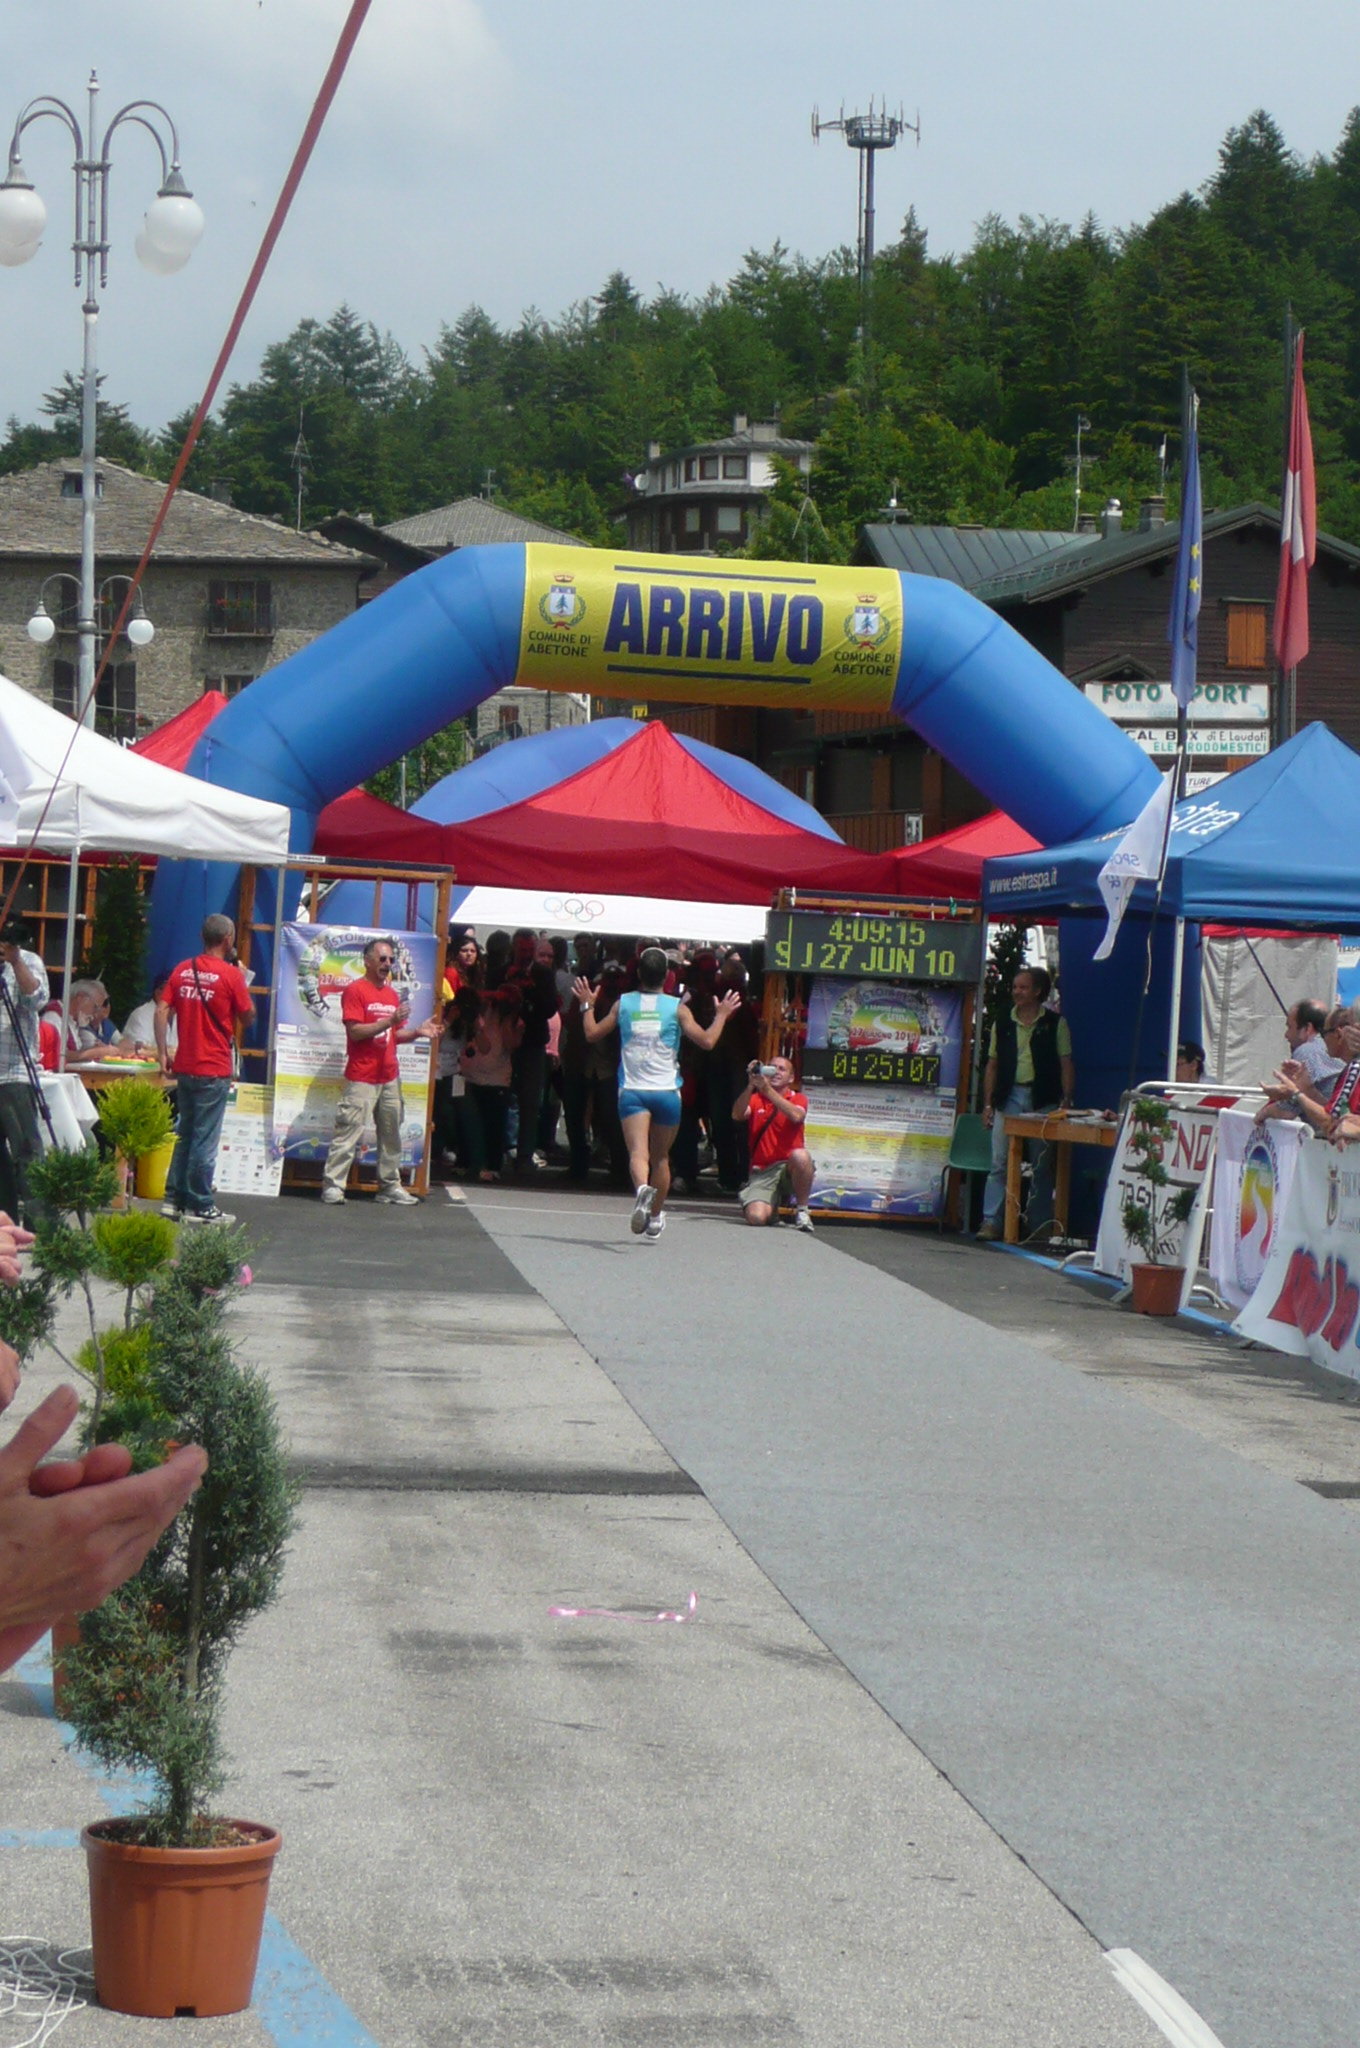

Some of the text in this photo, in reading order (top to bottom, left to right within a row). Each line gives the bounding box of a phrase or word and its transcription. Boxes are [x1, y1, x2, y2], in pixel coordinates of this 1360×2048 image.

[603, 582, 825, 666] ARRIVO
[528, 630, 592, 645] COMUNE DI
[527, 644, 589, 658] ABETONE
[833, 650, 896, 665] COMUNE DI
[832, 664, 893, 677] ABETONE
[1102, 683, 1163, 703] FOTO
[1165, 730, 1199, 741] BX
[988, 868, 1058, 893] www.estraspa.it
[829, 917, 926, 947] 4:09:15
[820, 943, 853, 970] 27
[860, 948, 914, 975] JUN
[925, 949, 955, 975] 10
[832, 1051, 940, 1083] 0:25:07
